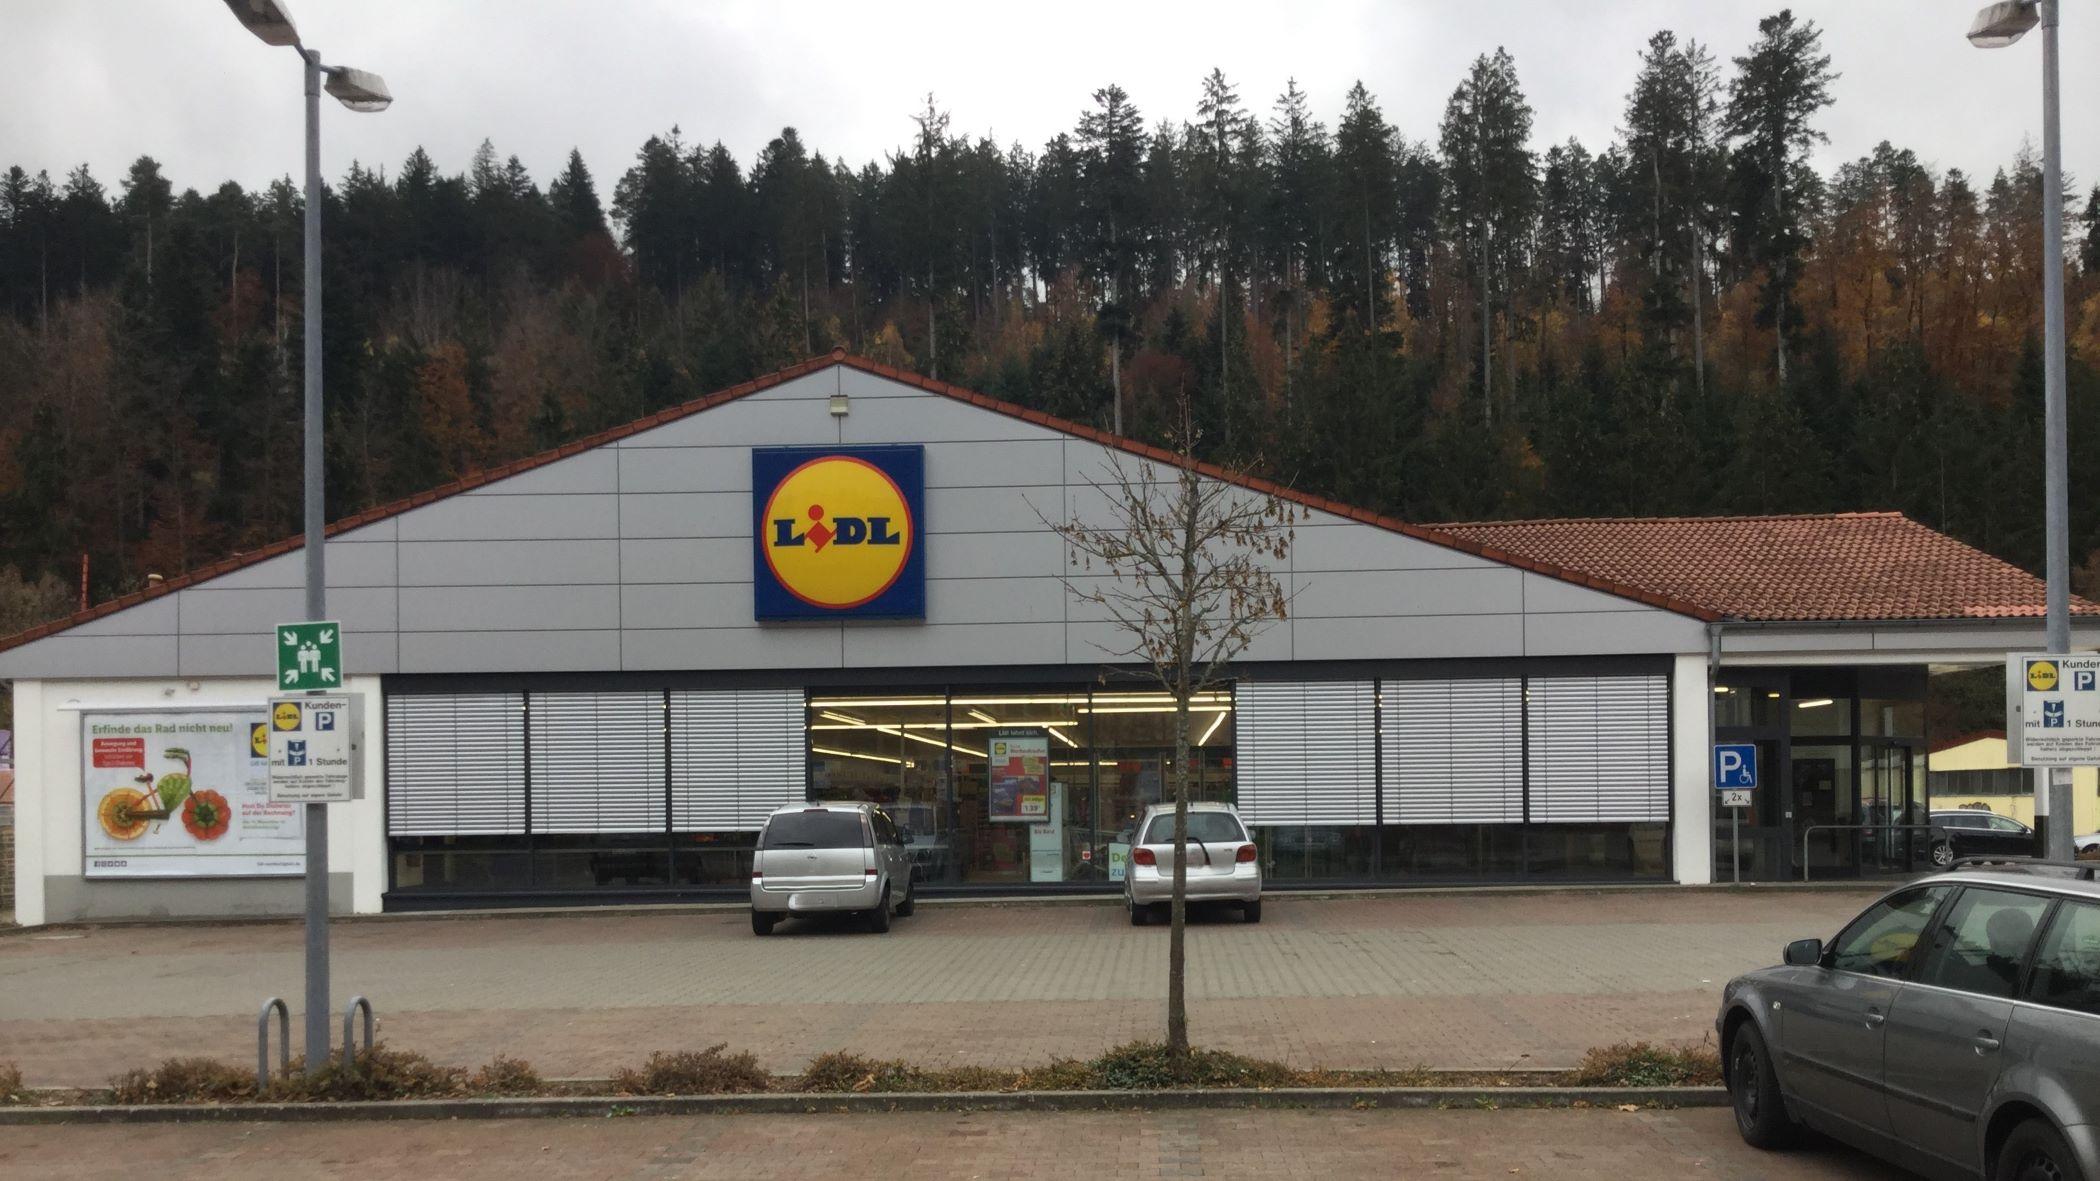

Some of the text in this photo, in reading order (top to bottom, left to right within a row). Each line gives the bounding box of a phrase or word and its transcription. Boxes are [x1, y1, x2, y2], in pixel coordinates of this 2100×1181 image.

[774, 504, 900, 553] LIDL
[2030, 670, 2056, 680] LIDL
[2078, 672, 2092, 690] P
[304, 702, 346, 710] Kunden-
[92, 723, 233, 734] Erfinde das Rad nicht neu!
[318, 713, 332, 730] P
[316, 758, 348, 766] Stunde
[1720, 751, 1741, 783] P
